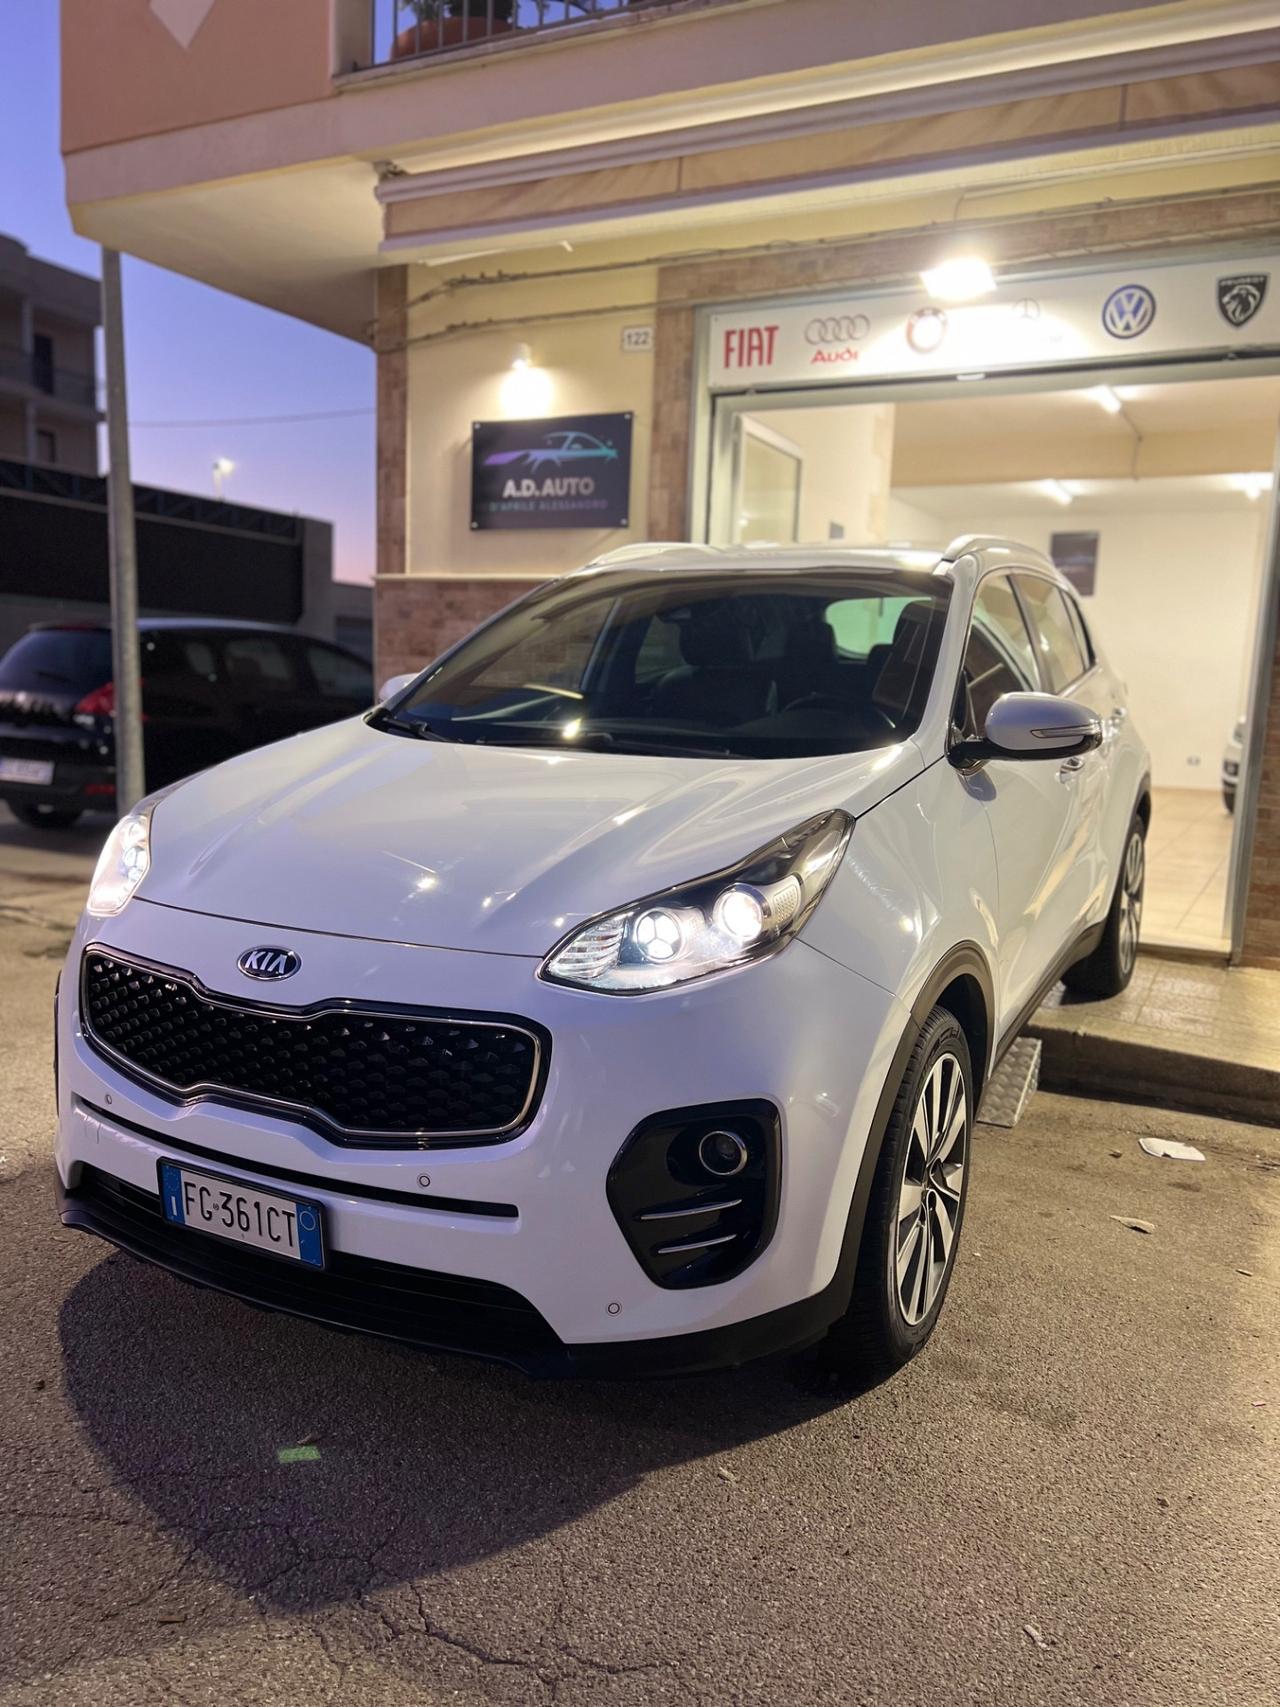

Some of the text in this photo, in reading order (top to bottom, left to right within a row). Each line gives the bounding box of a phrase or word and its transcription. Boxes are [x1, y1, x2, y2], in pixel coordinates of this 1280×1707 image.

[627, 331, 650, 345] 122
[724, 325, 779, 368] FIAT
[810, 348, 859, 364] Audi
[244, 951, 288, 974] KIA
